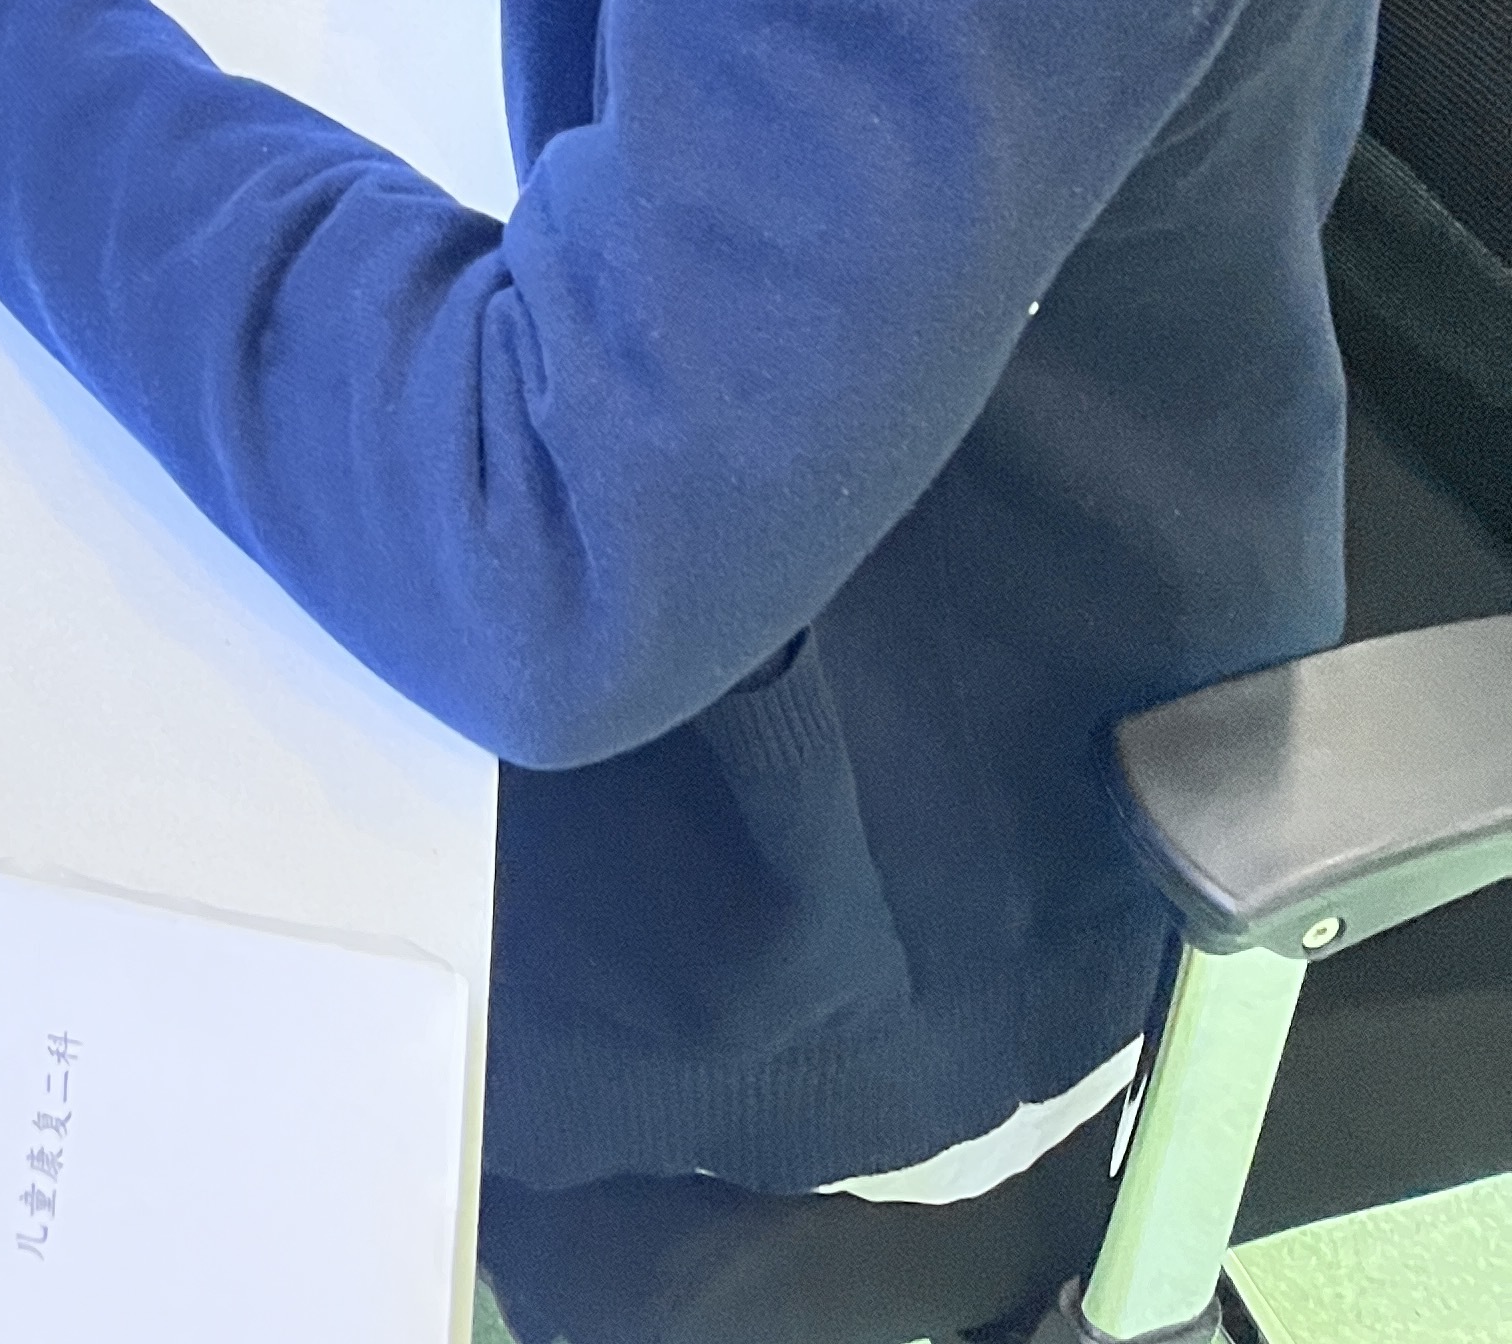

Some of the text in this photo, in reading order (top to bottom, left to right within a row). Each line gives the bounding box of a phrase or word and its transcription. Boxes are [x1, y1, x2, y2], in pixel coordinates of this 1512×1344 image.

[15, 1030, 83, 1261] 儿童康复二科
